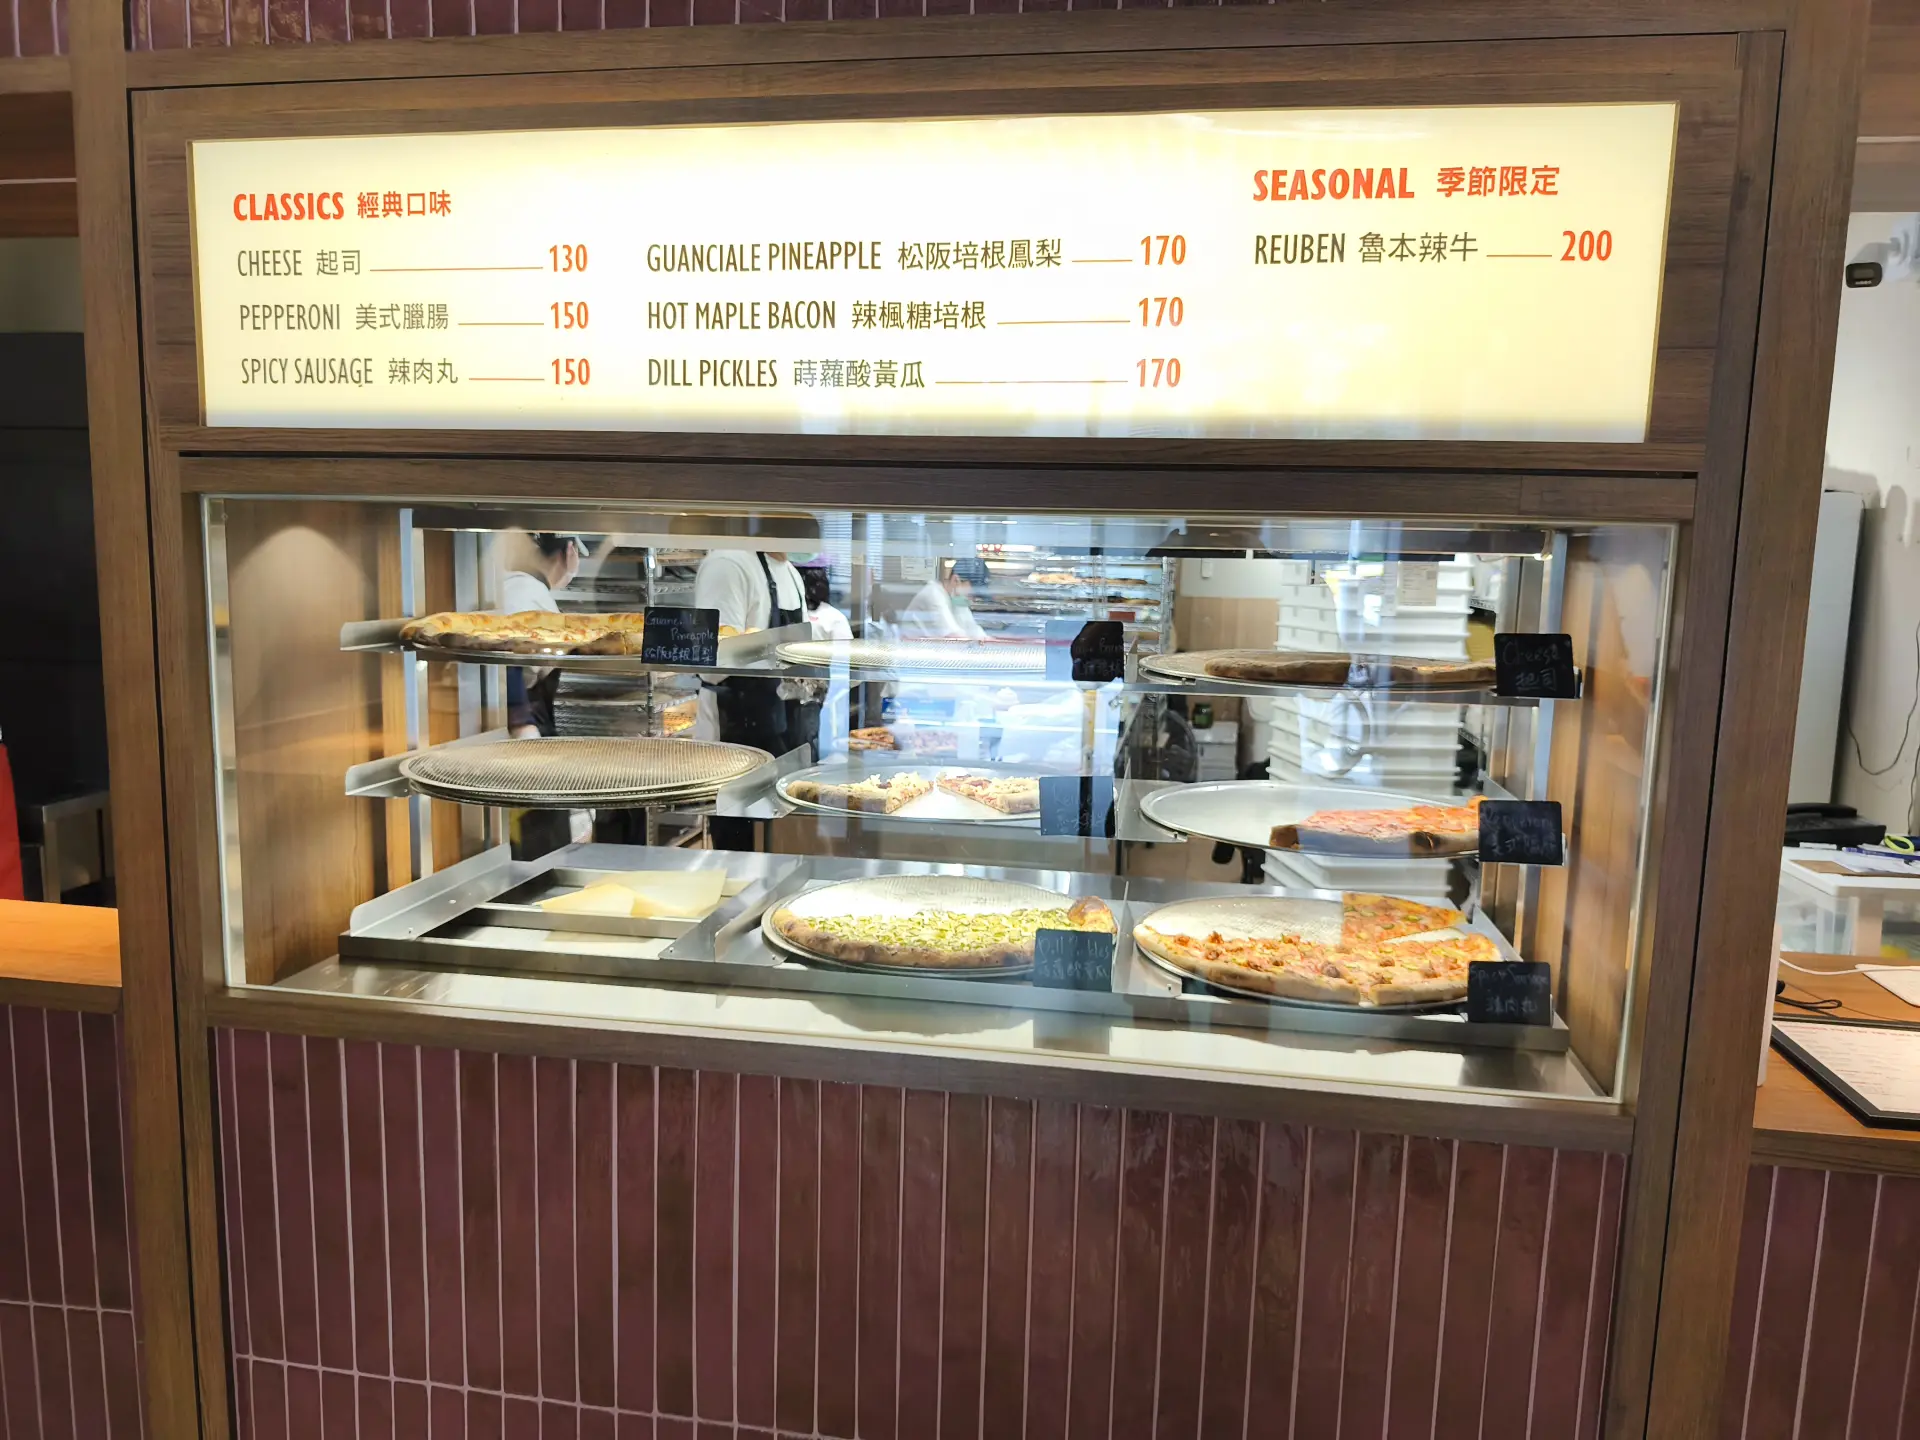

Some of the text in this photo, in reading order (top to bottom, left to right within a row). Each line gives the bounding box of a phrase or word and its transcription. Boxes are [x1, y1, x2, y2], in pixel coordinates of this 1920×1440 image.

[1252, 164, 1560, 202] SEASONAL 季節限定
[233, 189, 452, 222] CLASSICS 經典口味
[237, 243, 588, 277] CHEESE 起司 130
[646, 234, 1187, 273] GUANCIALE PINEAPPLE 松阪培根鳳梨 170
[1254, 229, 1613, 265] REUBEN 魯本辣牛 200
[239, 301, 589, 331] PEPPERONI 美式臘腸 150
[648, 296, 1184, 330] HOT MAPLE BACON 辣楓糖培根 170
[241, 357, 591, 388] SPICY SAUSAGE 辣肉丸 150
[648, 357, 1182, 389] DILL PICKLES 蒔蘿酸黃瓜 170
